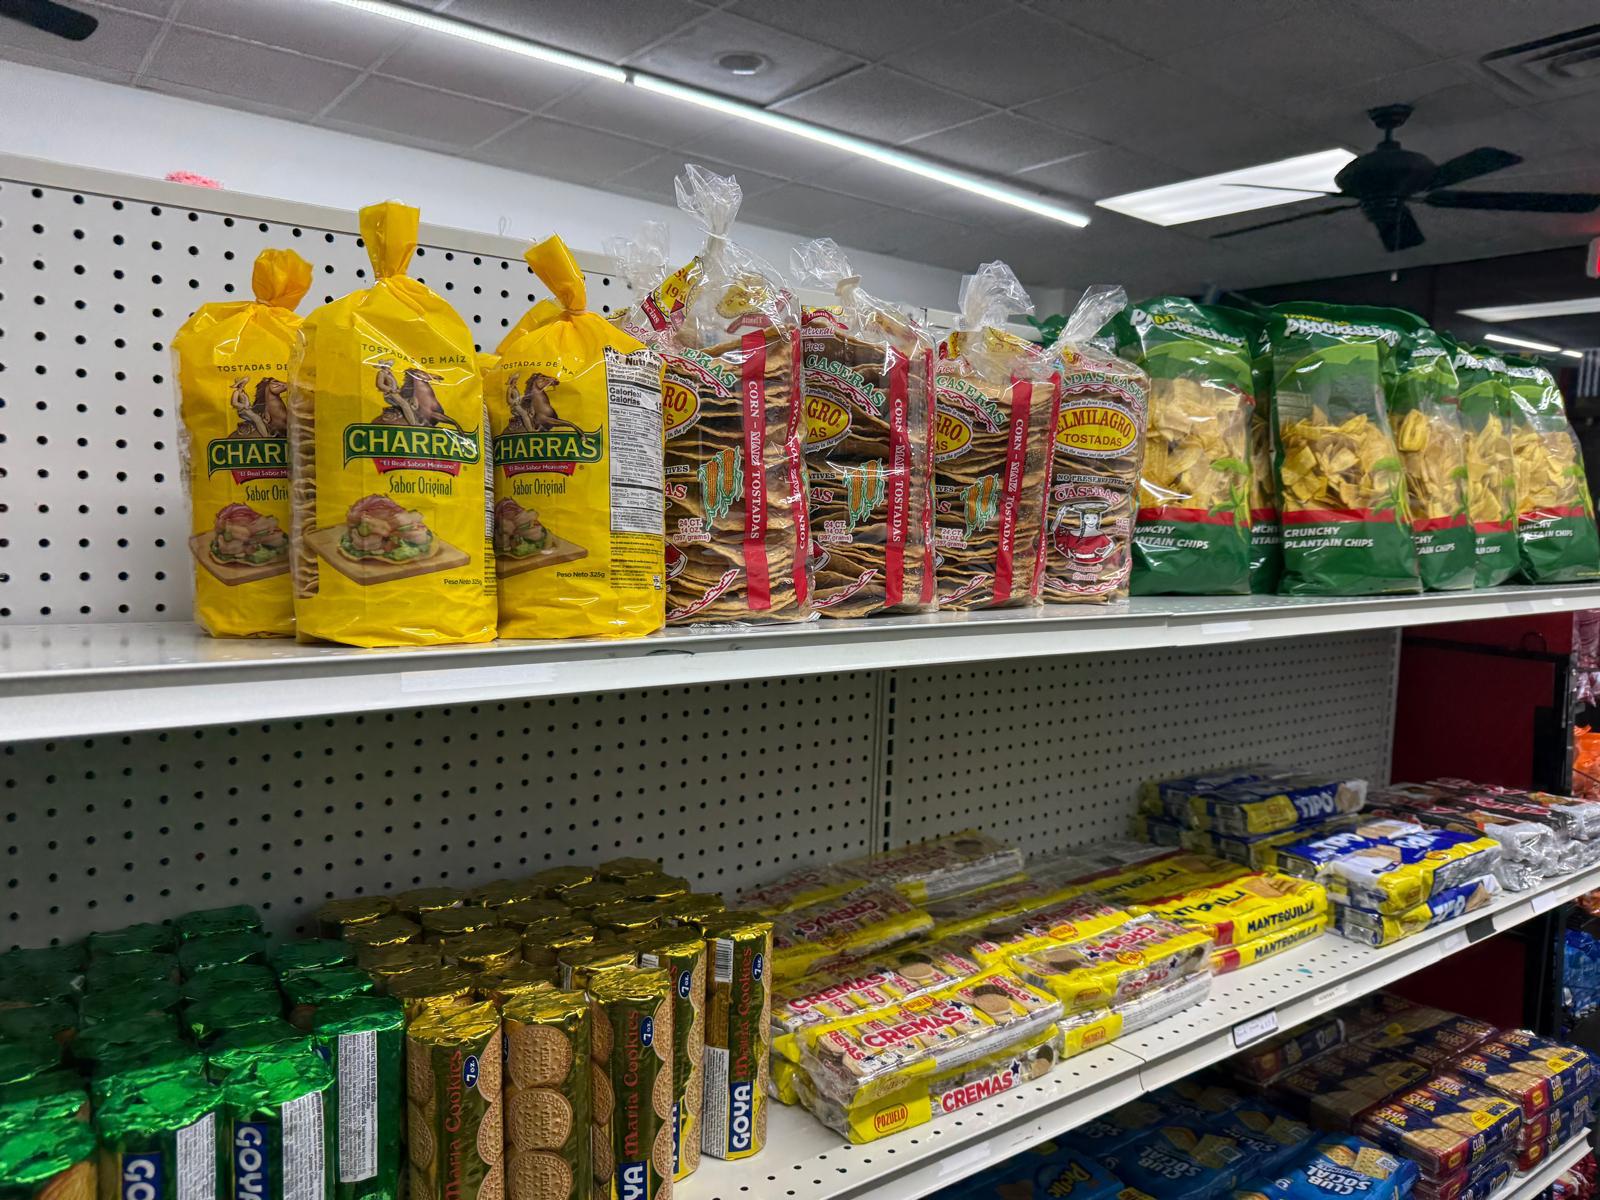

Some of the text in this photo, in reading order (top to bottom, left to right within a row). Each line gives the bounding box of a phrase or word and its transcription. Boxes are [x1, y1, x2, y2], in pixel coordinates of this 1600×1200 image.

[362, 343, 414, 364] TOSTADAS
[439, 355, 467, 364] MAÍZ
[501, 361, 541, 370] OSTADAS
[217, 362, 272, 373] TOSTADAS
[806, 354, 886, 406] CASERAS
[748, 381, 760, 418] CORN
[936, 375, 1007, 425] CASERAS
[895, 399, 904, 432] CORN
[349, 429, 477, 458] CHARRAS
[809, 427, 827, 438] AS
[1013, 419, 1024, 450] CORN
[1064, 433, 1122, 447] TOSTADAS
[246, 486, 270, 501] Sabor
[389, 475, 452, 497] Sabor Original
[513, 477, 566, 496] Sabor Original
[750, 471, 761, 538] TOSTADAS
[893, 481, 904, 542] TOSTADAS
[1002, 496, 1015, 551] TOSTADAS
[1284, 526, 1341, 538] CRUNCHY
[1177, 539, 1209, 549] CHIPS
[1284, 538, 1374, 549] PLANTAIN CHIPS
[459, 578, 471, 586] Neto
[589, 571, 605, 579] 325g
[1294, 792, 1334, 818] TIPO
[797, 899, 880, 932] CREMAS
[1247, 900, 1315, 934] MANTEQUILLA
[1254, 924, 1318, 959] MANTEQUILLA
[738, 948, 752, 1017] Cookies
[754, 967, 762, 975] 7
[681, 985, 689, 993] 7
[788, 973, 888, 1010] CREMAS
[643, 1033, 651, 1041] 7
[863, 1007, 966, 1047] CREMAS
[466, 1074, 476, 1082] 7
[623, 1009, 640, 1156] Maria Cookies
[444, 1050, 462, 1133] Cookies
[942, 1070, 1013, 1113] CREMAS
[732, 1085, 751, 1149] GOYA
[876, 1109, 906, 1127] POZUELO
[1308, 1175, 1355, 1196] CLUB
